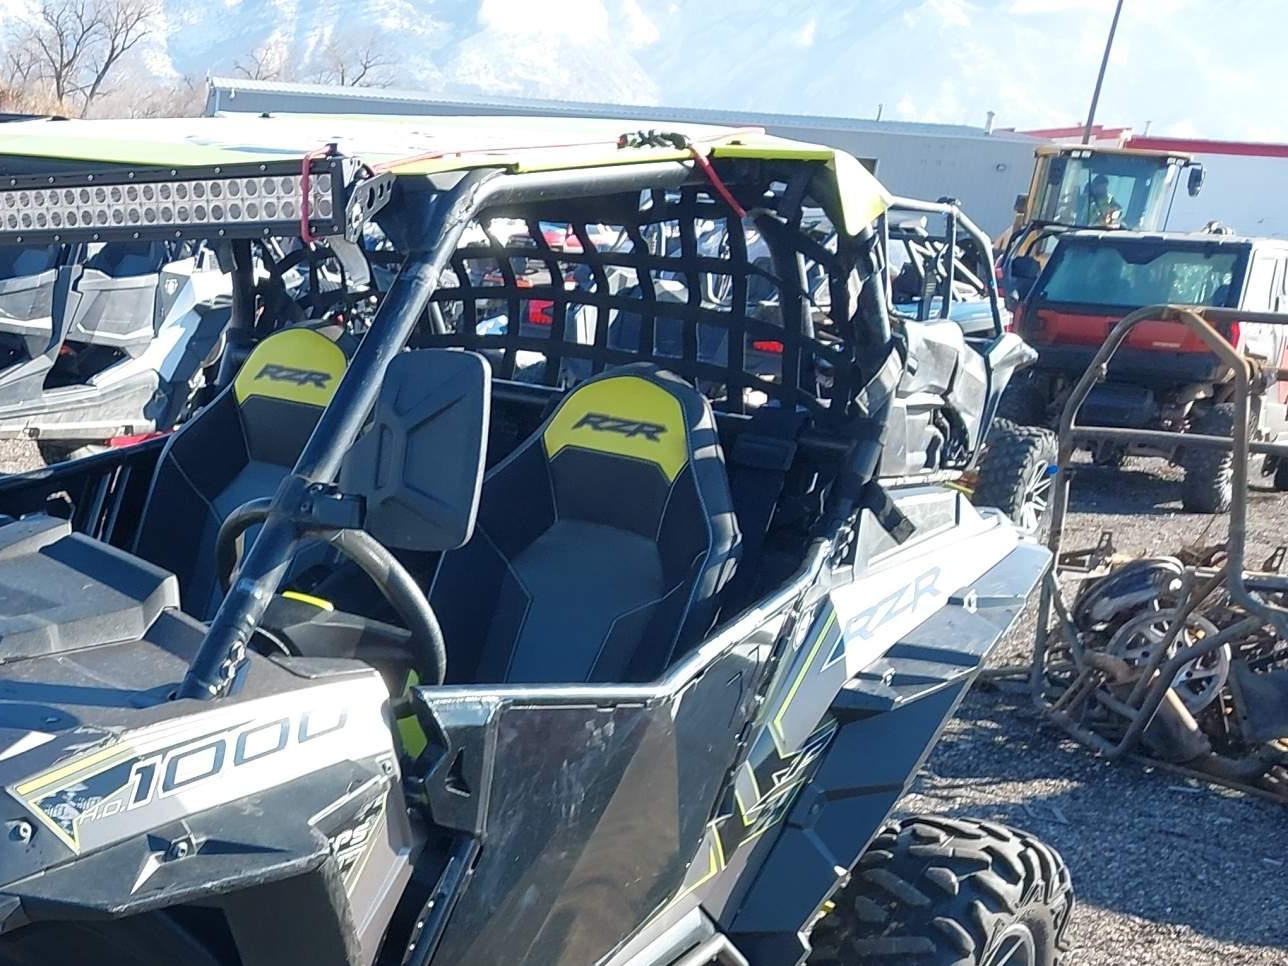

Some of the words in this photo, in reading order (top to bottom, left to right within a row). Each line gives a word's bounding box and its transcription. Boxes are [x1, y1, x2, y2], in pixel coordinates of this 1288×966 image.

[254, 363, 332, 389] RZR
[571, 412, 669, 443] RZR
[843, 565, 943, 643] RZR
[127, 705, 349, 810] 1000
